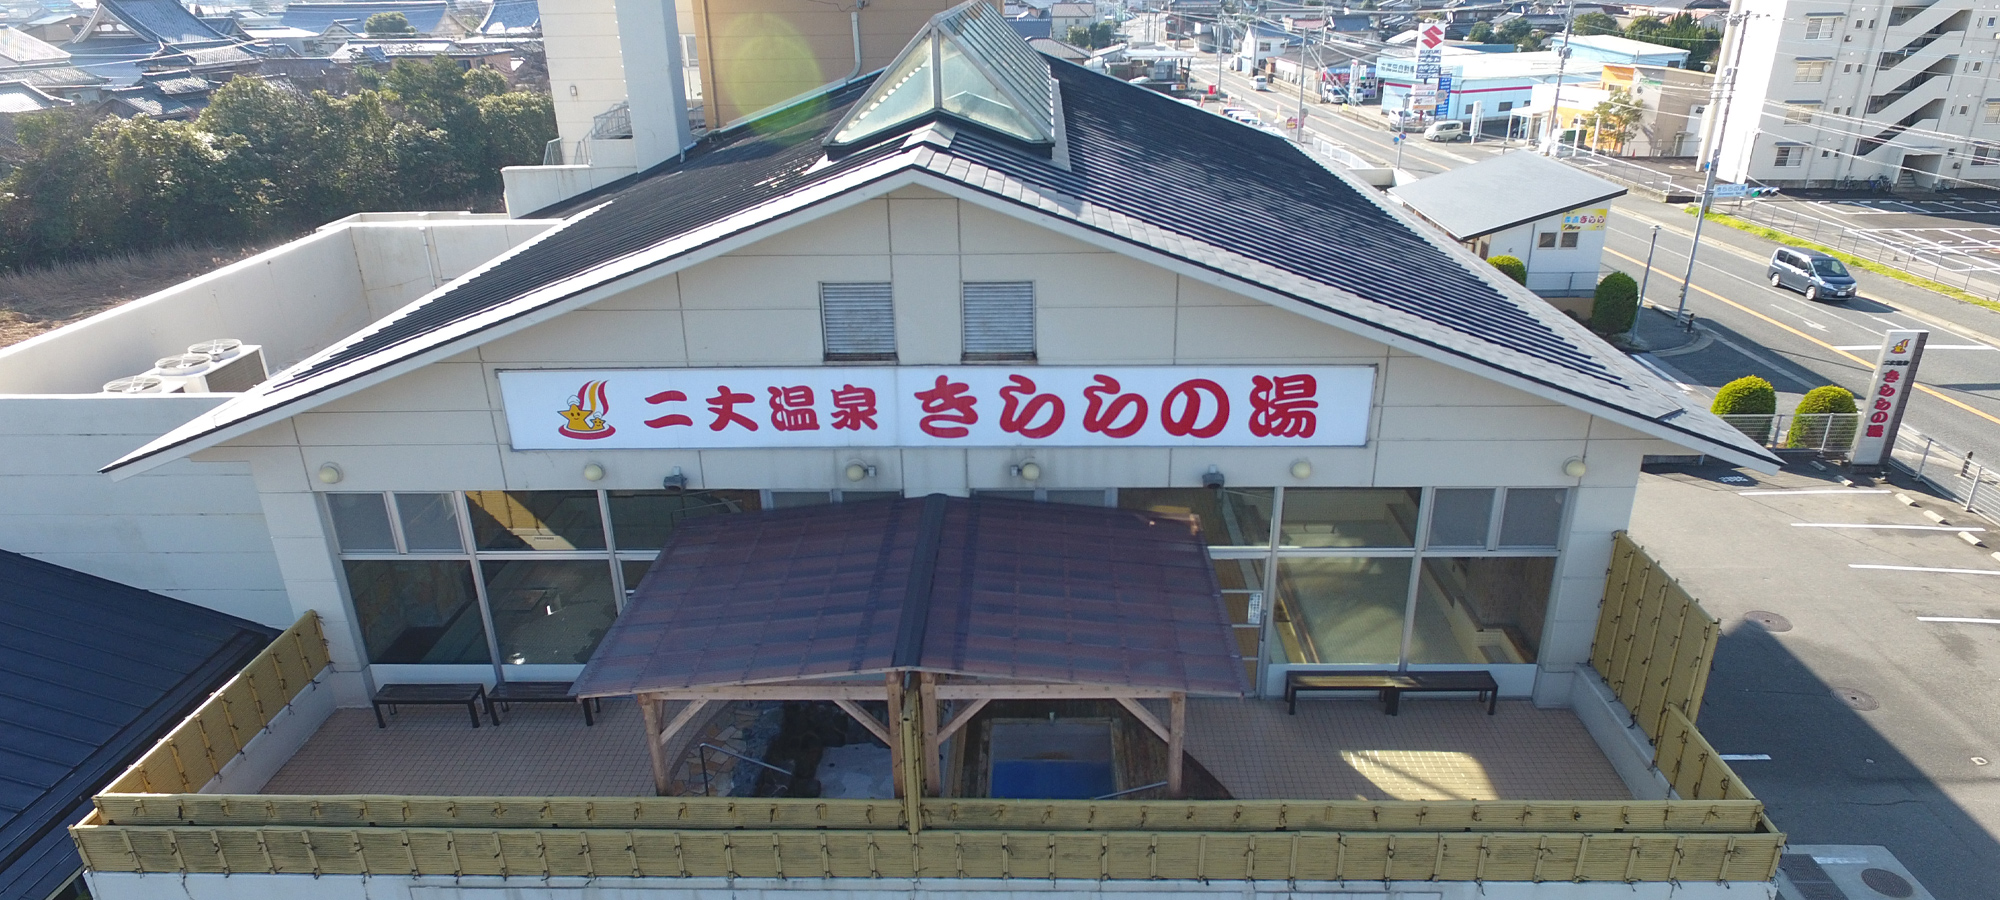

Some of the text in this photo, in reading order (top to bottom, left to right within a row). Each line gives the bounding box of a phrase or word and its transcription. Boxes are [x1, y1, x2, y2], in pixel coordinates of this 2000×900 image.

[643, 374, 1319, 440] 二丈温泉 きららの湯
